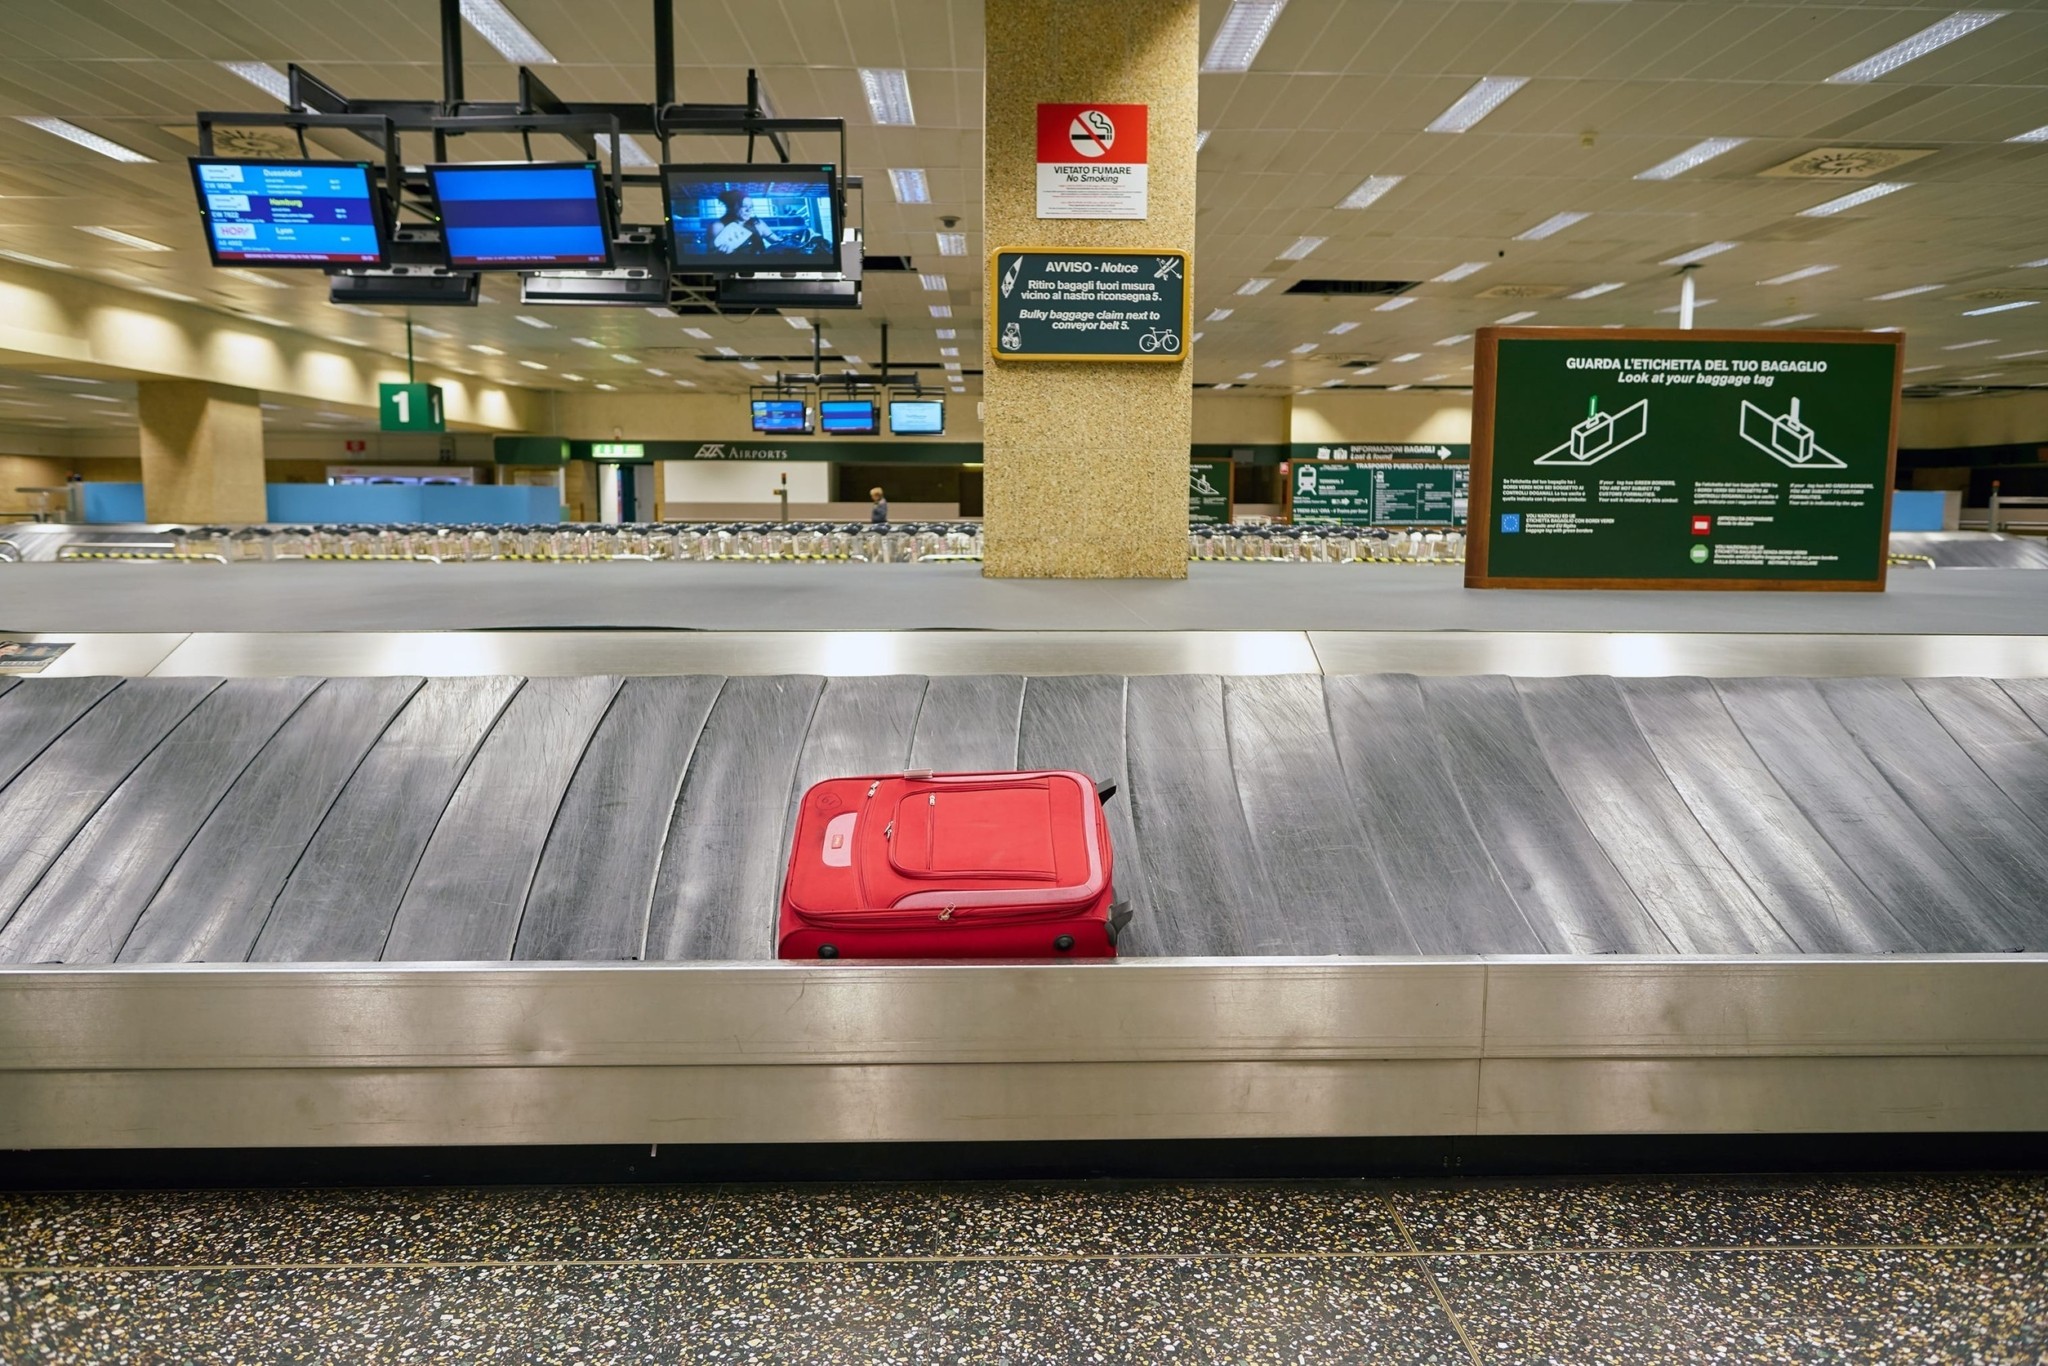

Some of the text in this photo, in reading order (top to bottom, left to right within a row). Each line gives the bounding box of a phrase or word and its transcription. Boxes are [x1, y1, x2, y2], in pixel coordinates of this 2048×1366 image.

[1054, 166, 1090, 174] VIETATO
[1080, 174, 1119, 184] Smoking
[269, 198, 303, 208] Hamburg
[275, 227, 294, 235] Lyon
[1046, 262, 1092, 272] AVVISO
[1101, 262, 1138, 273] Notice
[1028, 280, 1155, 292] Ritiro bagagli fuori misura
[1021, 291, 1051, 300] vicino
[1052, 291, 1062, 300] al
[1064, 292, 1095, 300] nastro
[1097, 292, 1151, 302] riconsegna
[1020, 310, 1160, 322] Bulky baggage claim next to
[1052, 322, 1099, 331] conveyor
[1100, 320, 1119, 330] belt
[1566, 357, 1827, 373] GUARDA L'ETICHETTA DEL TUO BAGAGLIO
[1618, 372, 1774, 388] Look at your baggage tag
[392, 390, 410, 423] 1
[432, 394, 440, 424] 1
